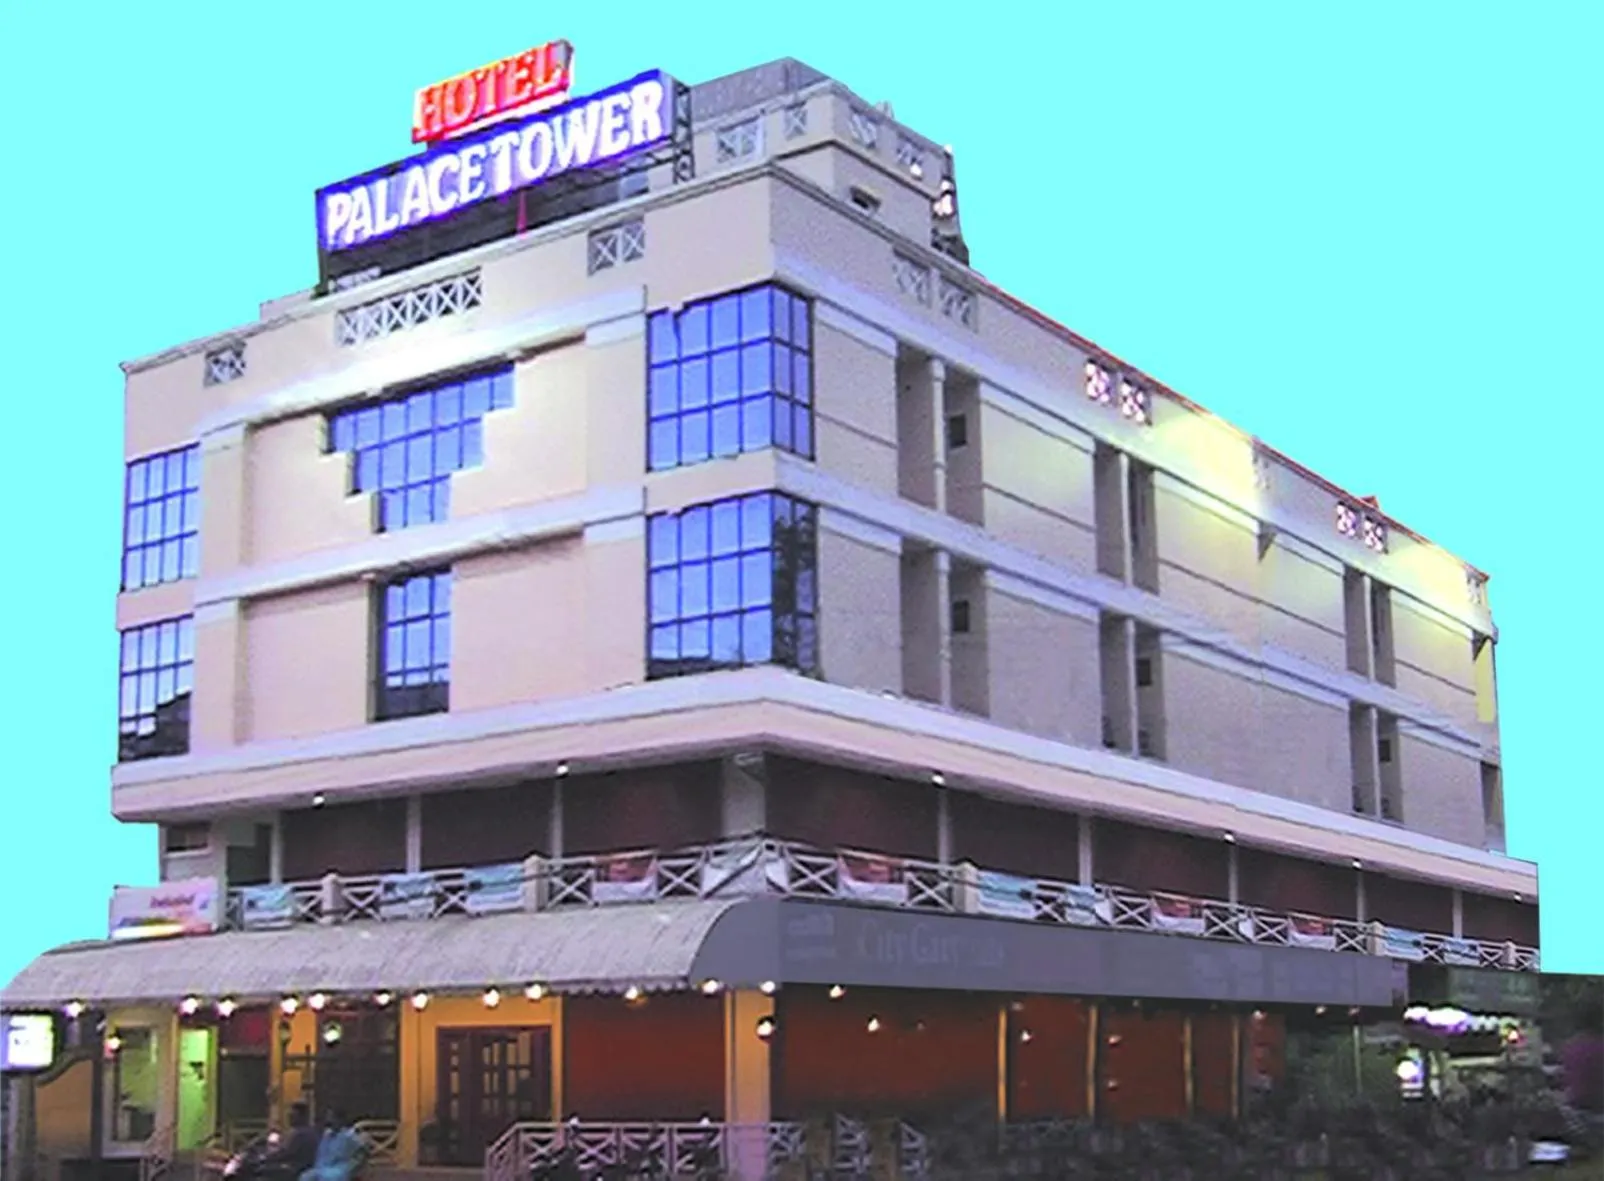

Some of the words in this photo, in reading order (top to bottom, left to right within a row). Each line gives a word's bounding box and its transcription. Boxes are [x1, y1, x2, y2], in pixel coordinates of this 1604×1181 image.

[415, 45, 563, 136] HOTEL
[326, 142, 486, 248] PALACE
[491, 79, 663, 193] TOWER
